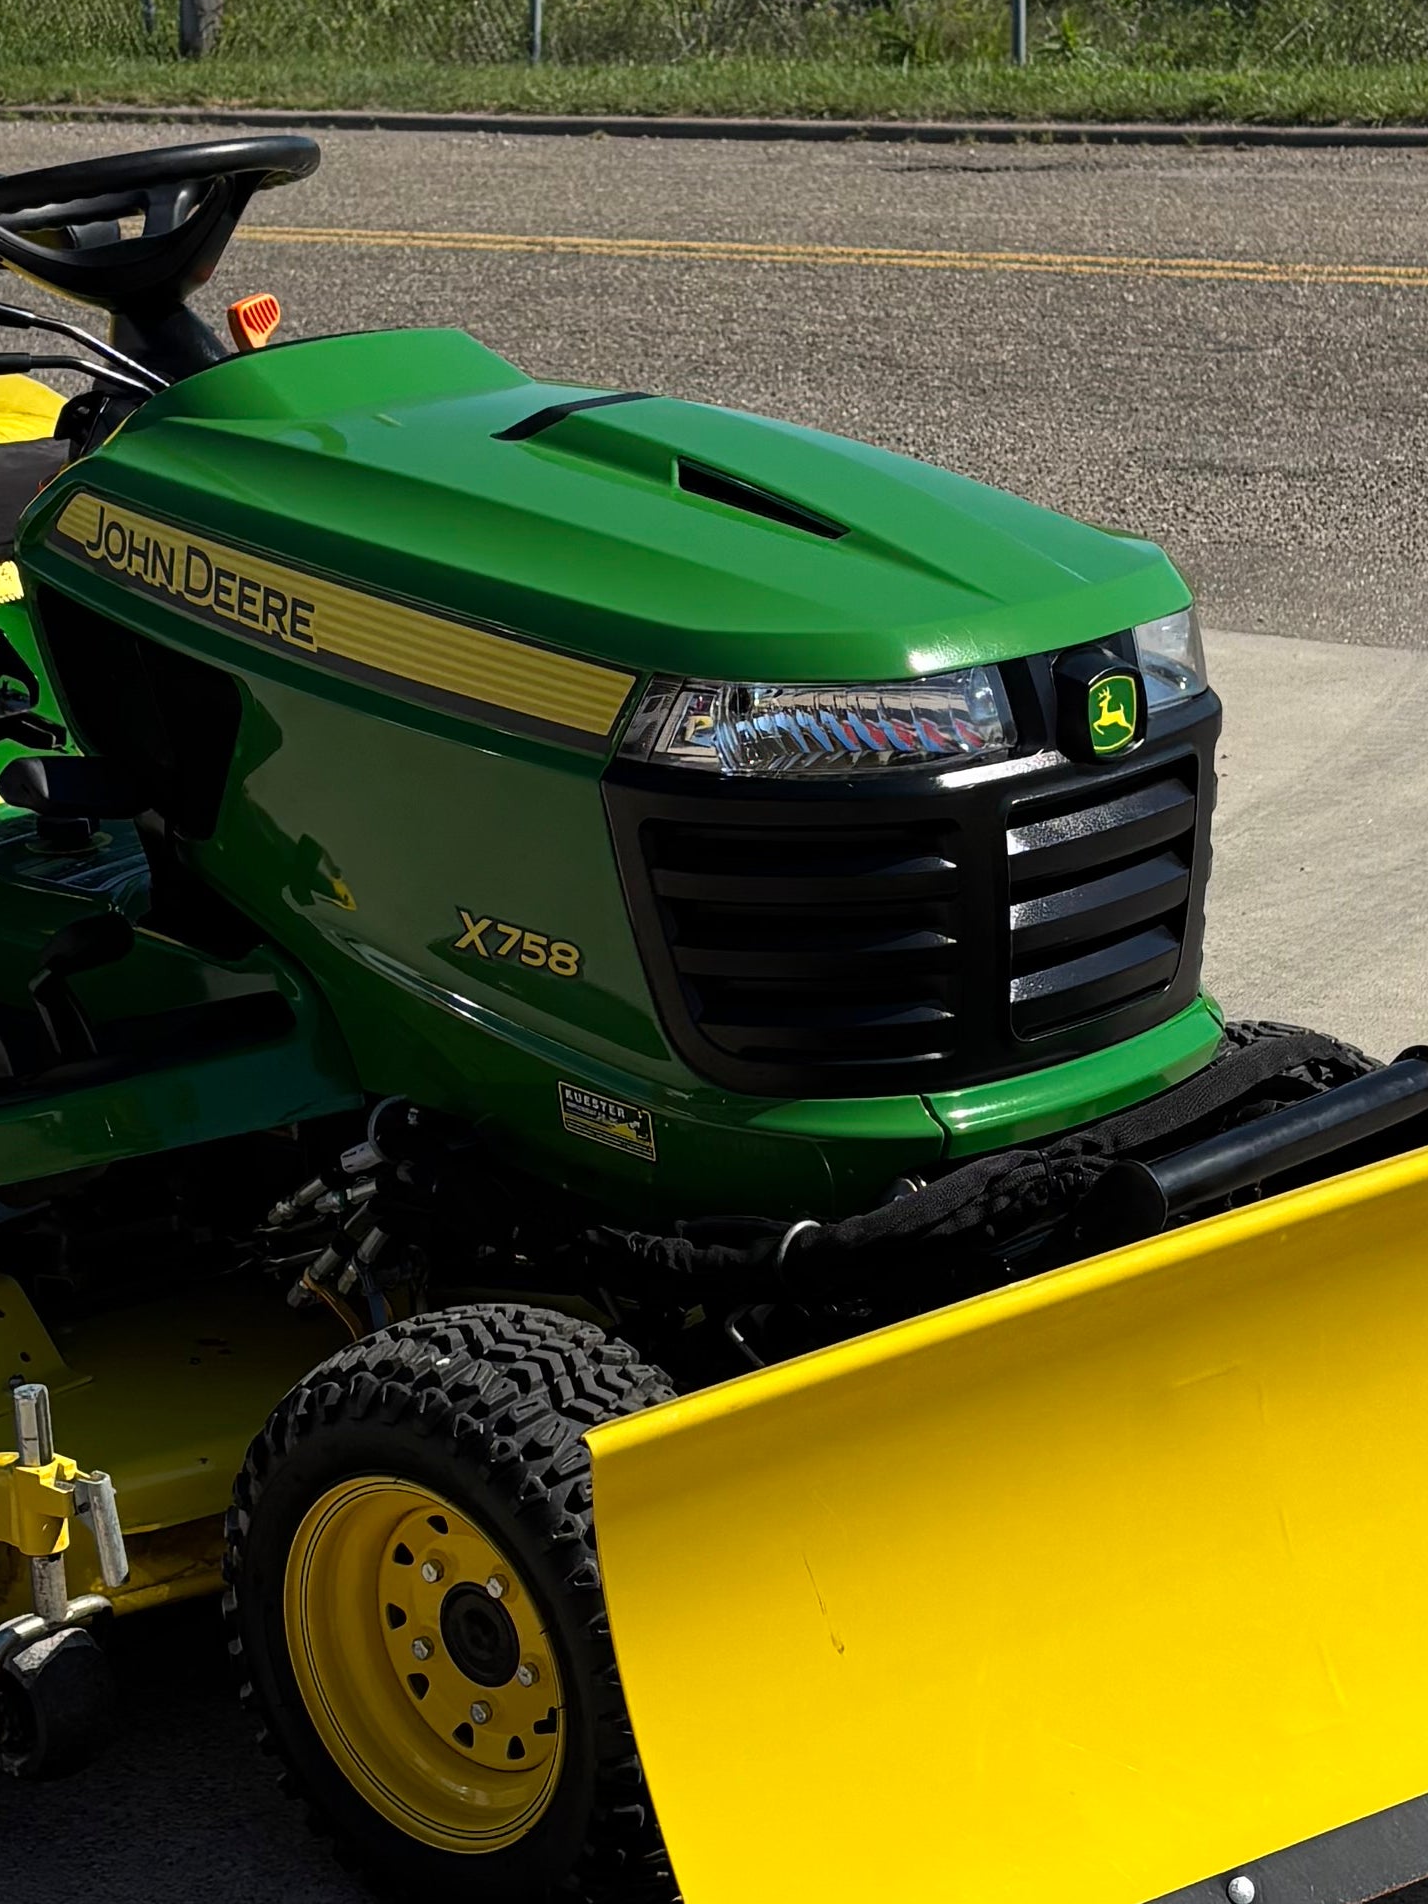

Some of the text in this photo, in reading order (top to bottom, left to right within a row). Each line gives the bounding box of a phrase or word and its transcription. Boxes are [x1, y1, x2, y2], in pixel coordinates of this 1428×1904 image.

[85, 505, 317, 647] JOHN DEERE
[453, 909, 582, 978] X758
